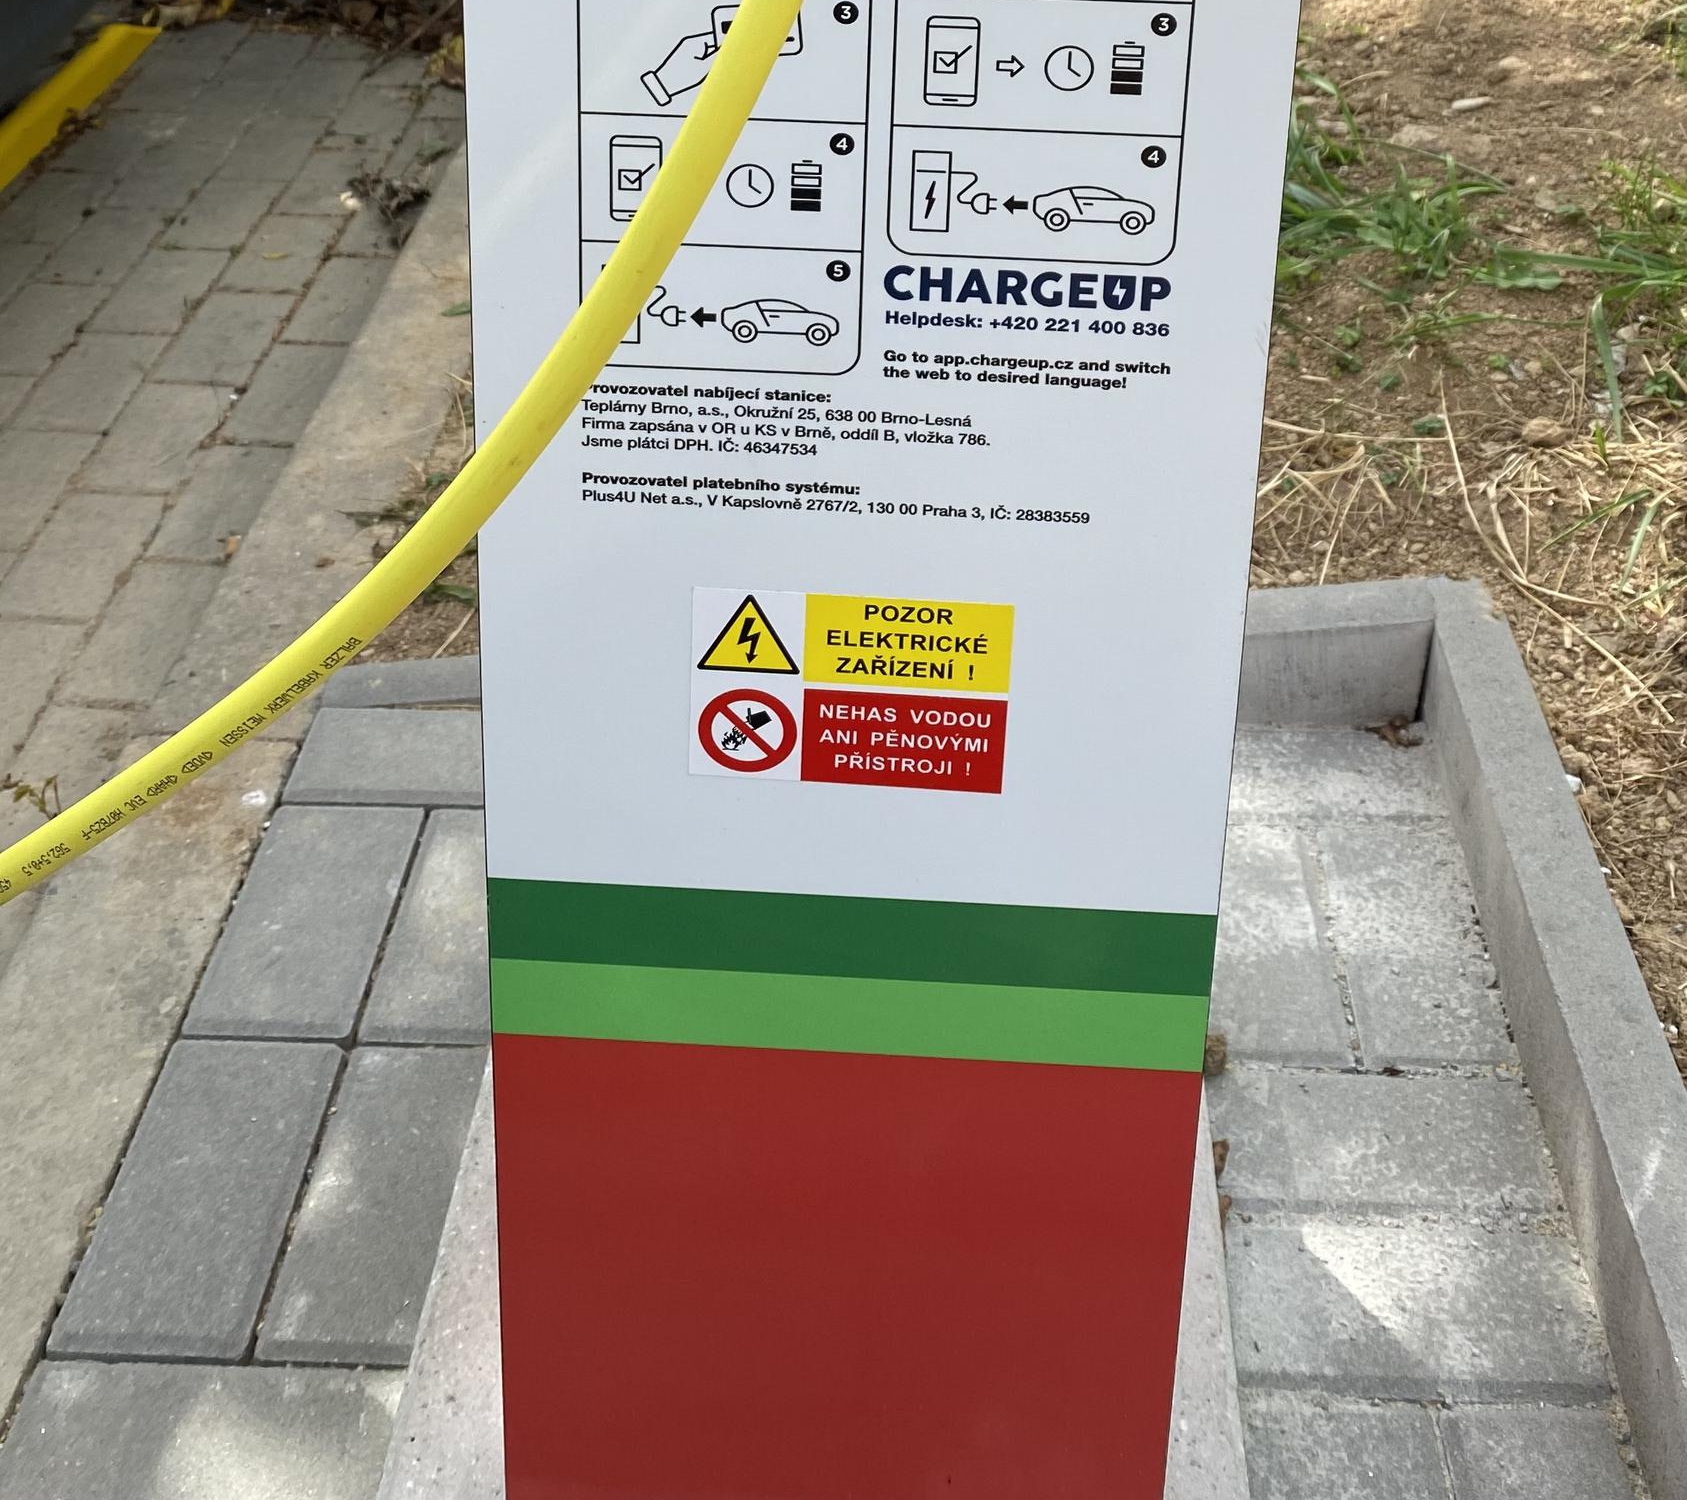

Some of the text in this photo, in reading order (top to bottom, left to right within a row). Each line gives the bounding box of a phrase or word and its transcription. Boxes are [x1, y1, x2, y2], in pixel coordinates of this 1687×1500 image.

[884, 265, 1171, 311] CHARGEUP
[885, 310, 1169, 337] Helpdesk: +420 221 400 836
[884, 350, 1170, 375] Go to app.chargeup.cz and switch
[883, 366, 1127, 390] the web to desired language!
[589, 384, 831, 403] rovozovatel nabíjecí stanice:
[581, 399, 972, 427] Teplárny Brno, a.s., Okružní 25, 638 00 Brno-Lesná
[582, 417, 990, 446] Firma zapsána v OR u KS v Brně, oddíl B, vložka 786.
[581, 435, 817, 456] Jsme plátci DPH. IČ: 46347534
[582, 472, 860, 495] Provozovatel platebního systému:
[582, 489, 1090, 524] Plus4U Net a.s., V Kapslovně 2767/2, 130 00 Praha 3, IČ: 28383559
[864, 604, 953, 625] POZOR
[319, 636, 363, 670] BALZER
[827, 629, 988, 654] ELEKTRICKÉ
[836, 655, 974, 681] ZAŘÍZENÍ !
[263, 668, 324, 714] KABELWERK
[820, 704, 991, 728] NEHAS VODOU
[218, 713, 267, 748] MEISSEN
[819, 729, 988, 752] ANI PĚNOVÝMI
[835, 752, 970, 776] PŘÍSTROJI !
